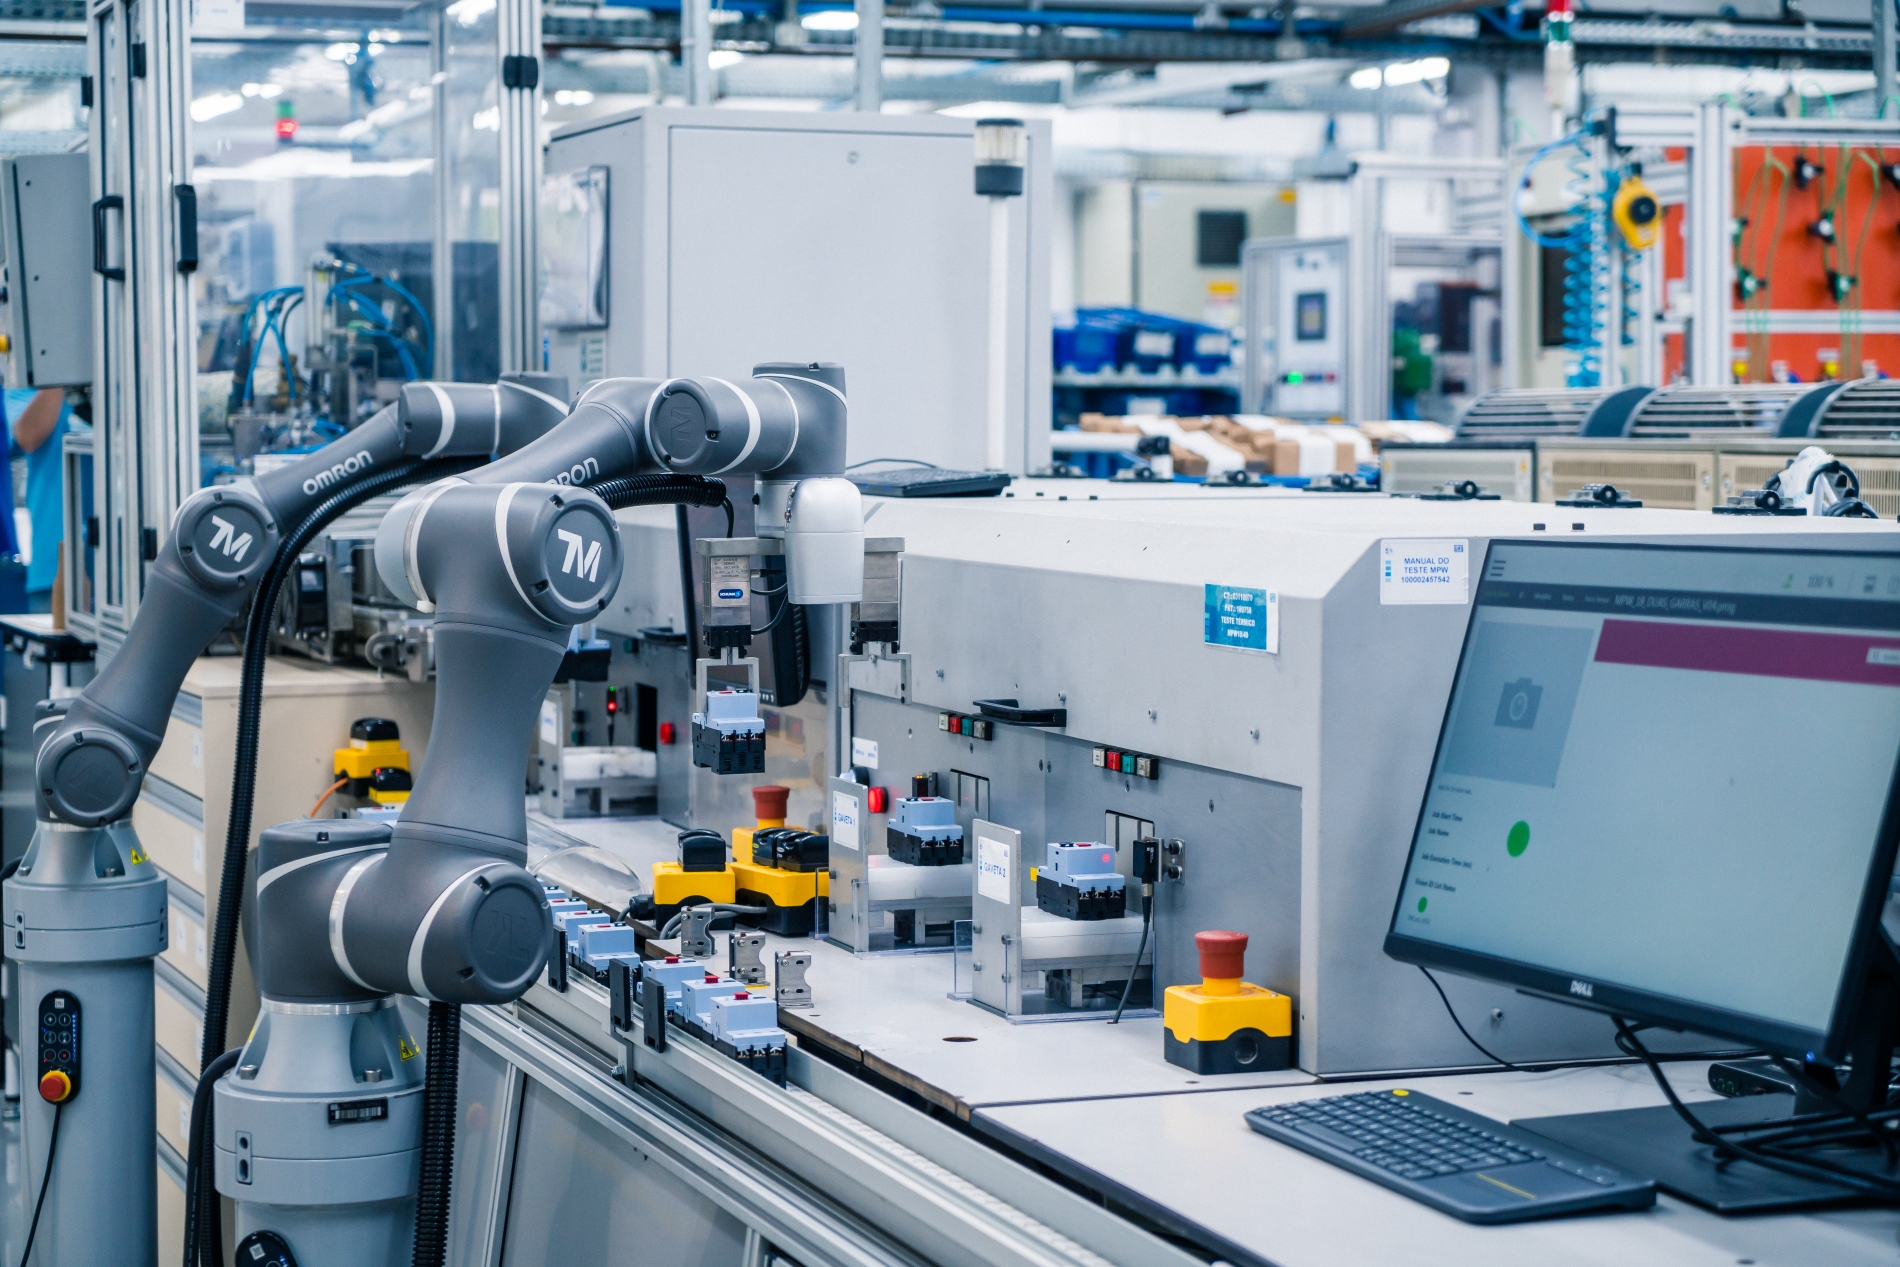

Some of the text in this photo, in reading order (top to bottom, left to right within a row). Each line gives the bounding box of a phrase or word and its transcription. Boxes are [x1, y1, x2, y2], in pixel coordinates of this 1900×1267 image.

[302, 450, 373, 496] OMRON
[1404, 557, 1450, 565] MANUAL DO
[1221, 616, 1235, 625] TESTE
